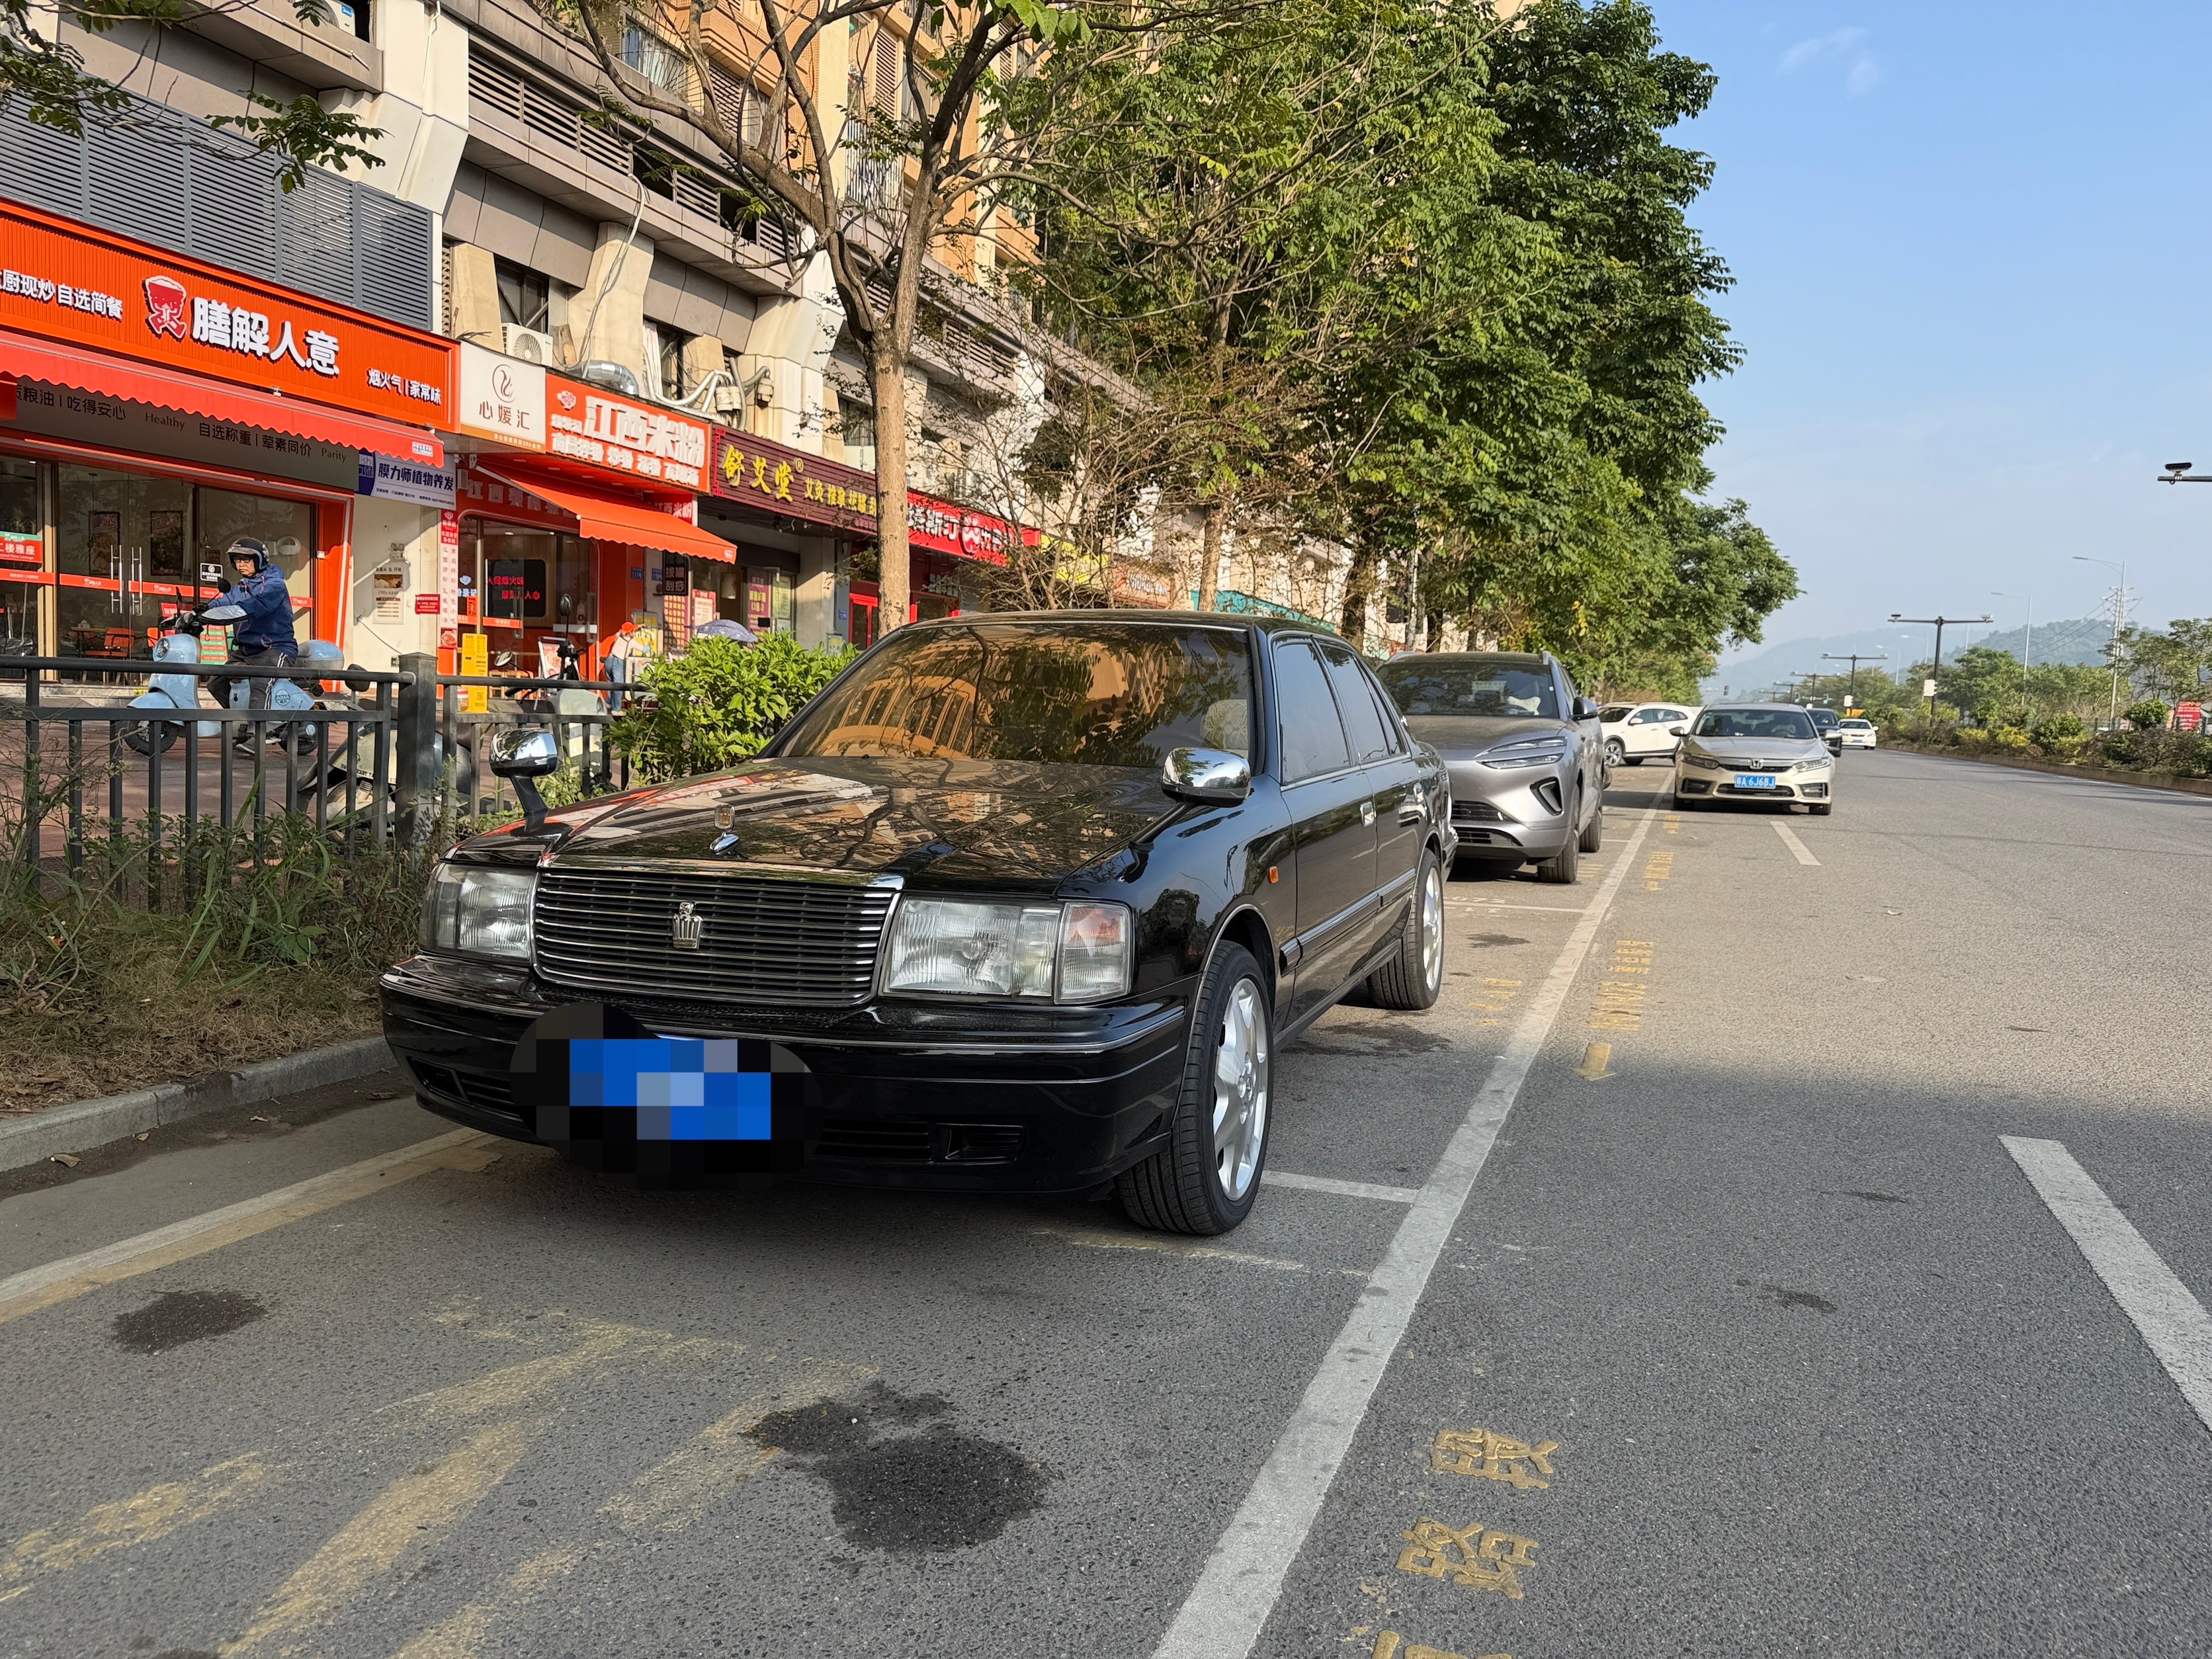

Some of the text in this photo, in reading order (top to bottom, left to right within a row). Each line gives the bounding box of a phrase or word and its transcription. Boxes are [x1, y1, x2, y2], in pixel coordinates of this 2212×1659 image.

[58, 283, 123, 319] 自选简餐
[192, 297, 340, 375] 膳解人意
[145, 412, 185, 431] Healthy
[583, 396, 705, 469] 江西米粉
[321, 447, 347, 464] Parity
[378, 463, 454, 491] 膜力师植物养发
